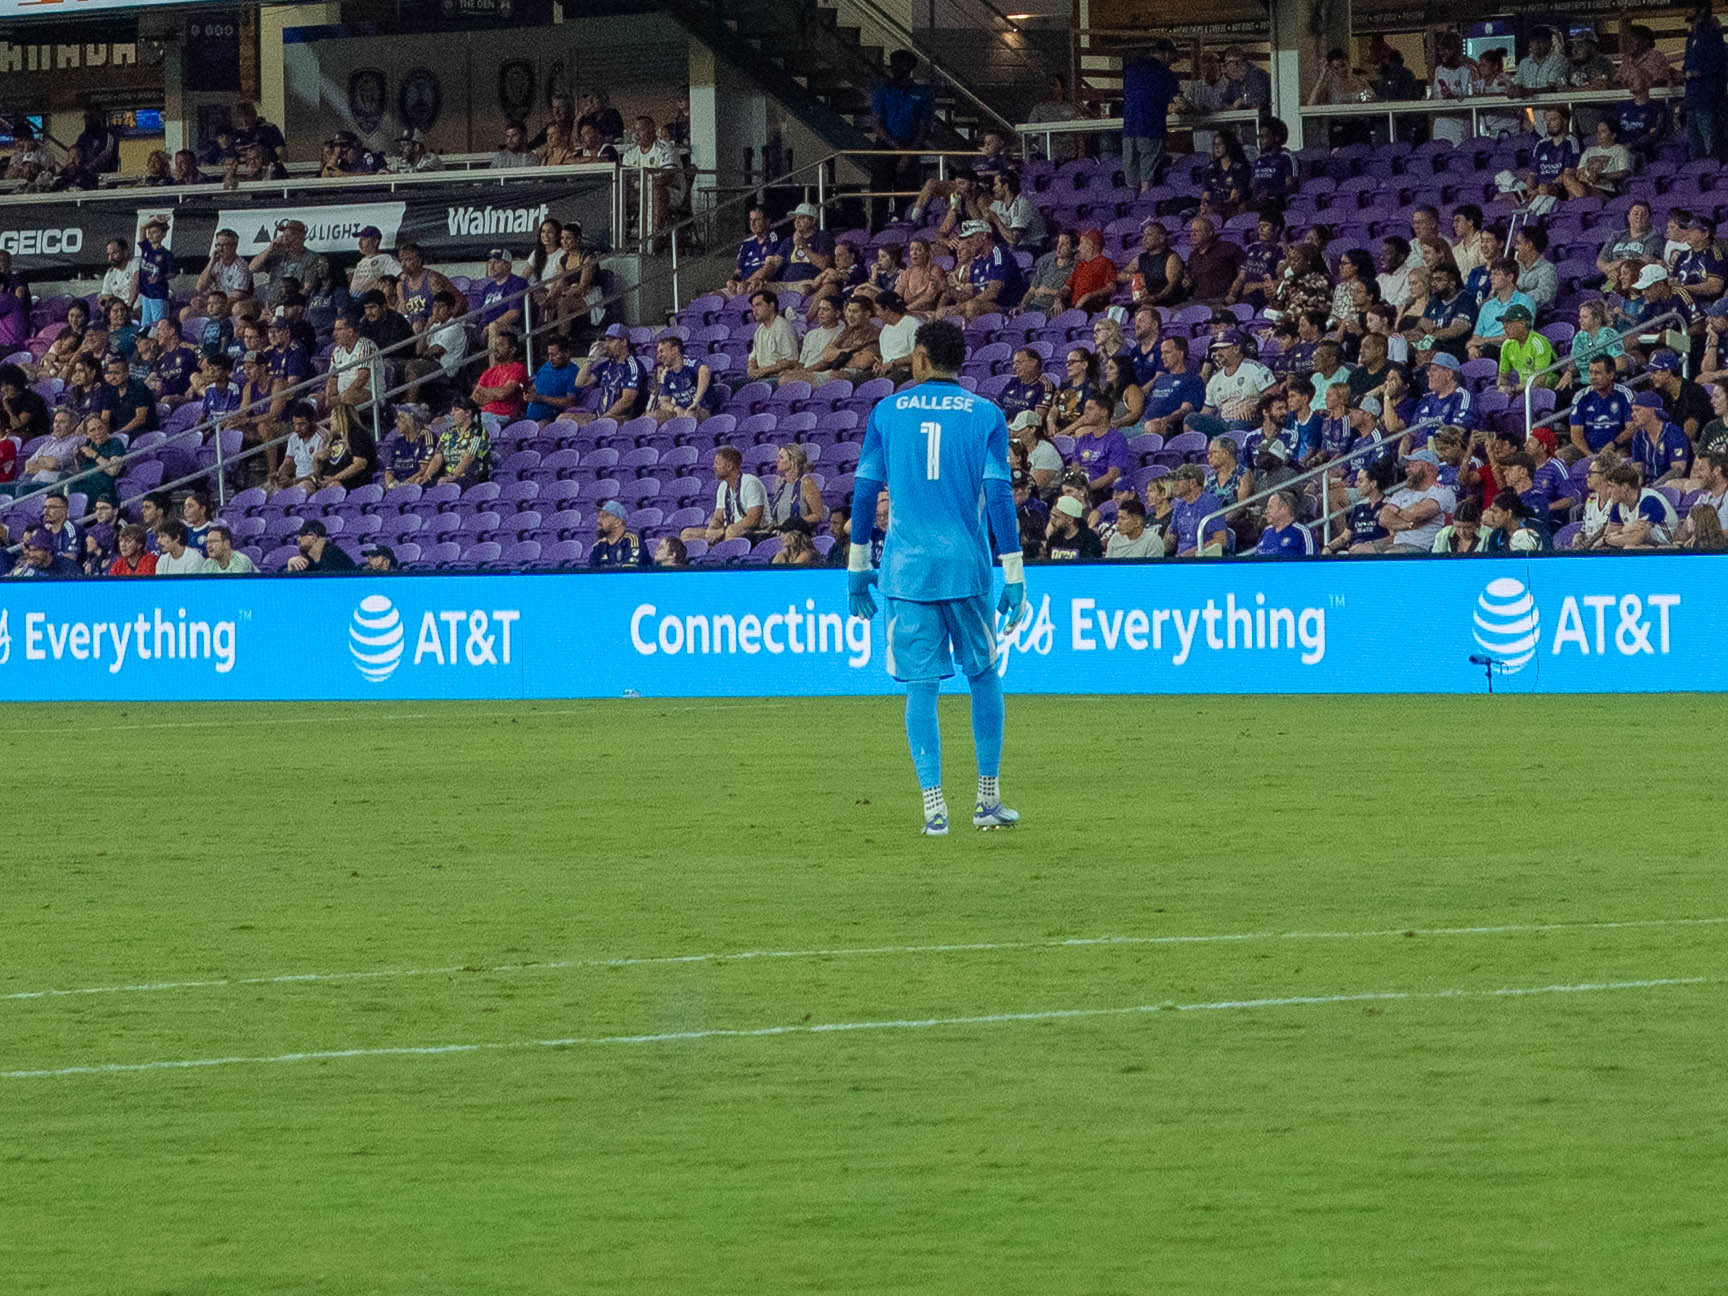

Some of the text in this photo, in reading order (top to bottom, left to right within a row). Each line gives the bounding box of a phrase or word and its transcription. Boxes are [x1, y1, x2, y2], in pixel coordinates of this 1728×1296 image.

[448, 203, 551, 237] Walmart
[895, 393, 975, 414] GALLESE
[919, 420, 942, 481] 1
[25, 608, 238, 675] Everything
[414, 610, 521, 665] AT&T
[630, 600, 873, 669] Connecting
[1071, 594, 1327, 667] Everything
[1553, 595, 1683, 657] AT&T
